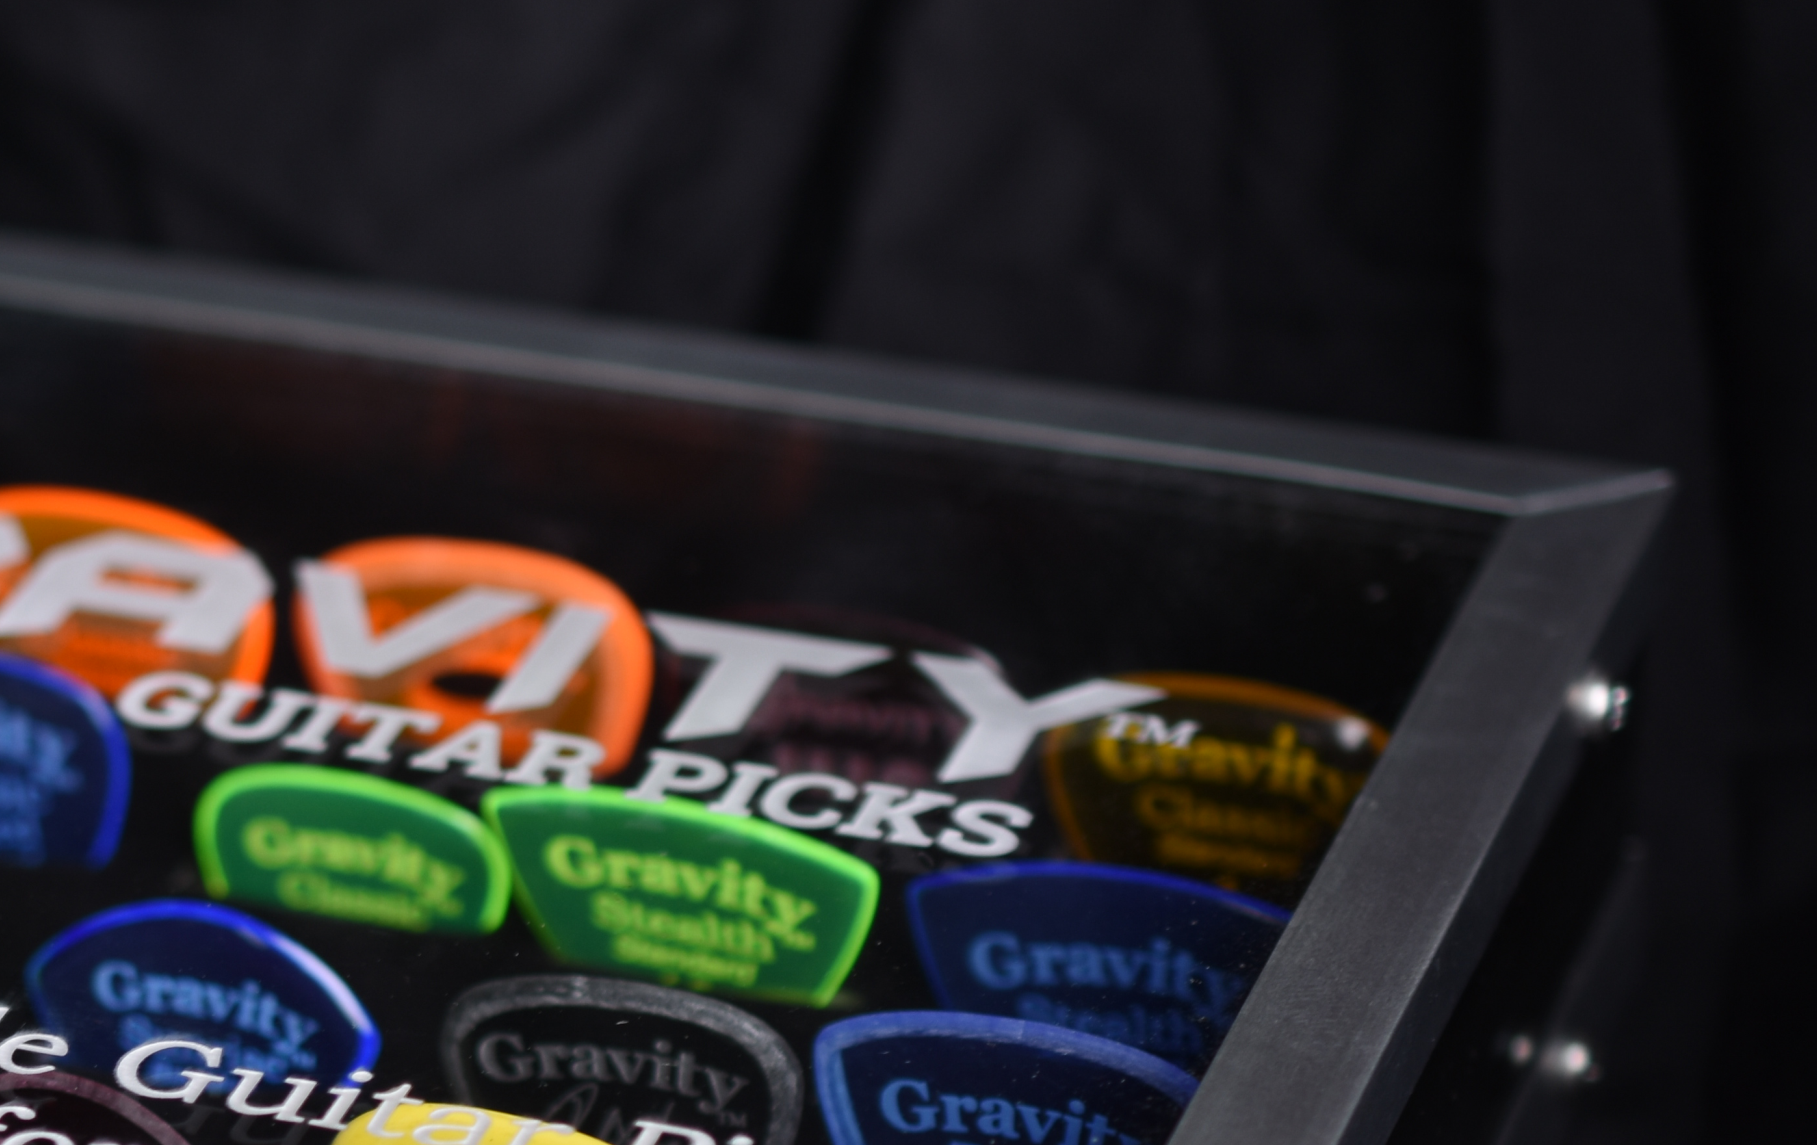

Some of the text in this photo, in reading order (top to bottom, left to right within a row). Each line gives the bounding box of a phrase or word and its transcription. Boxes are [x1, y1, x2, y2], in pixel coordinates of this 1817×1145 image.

[115, 670, 606, 789] GUITAR
[623, 744, 1034, 859] PICKS
[542, 833, 815, 934] Gravity
[474, 1030, 749, 1118] Gravity
